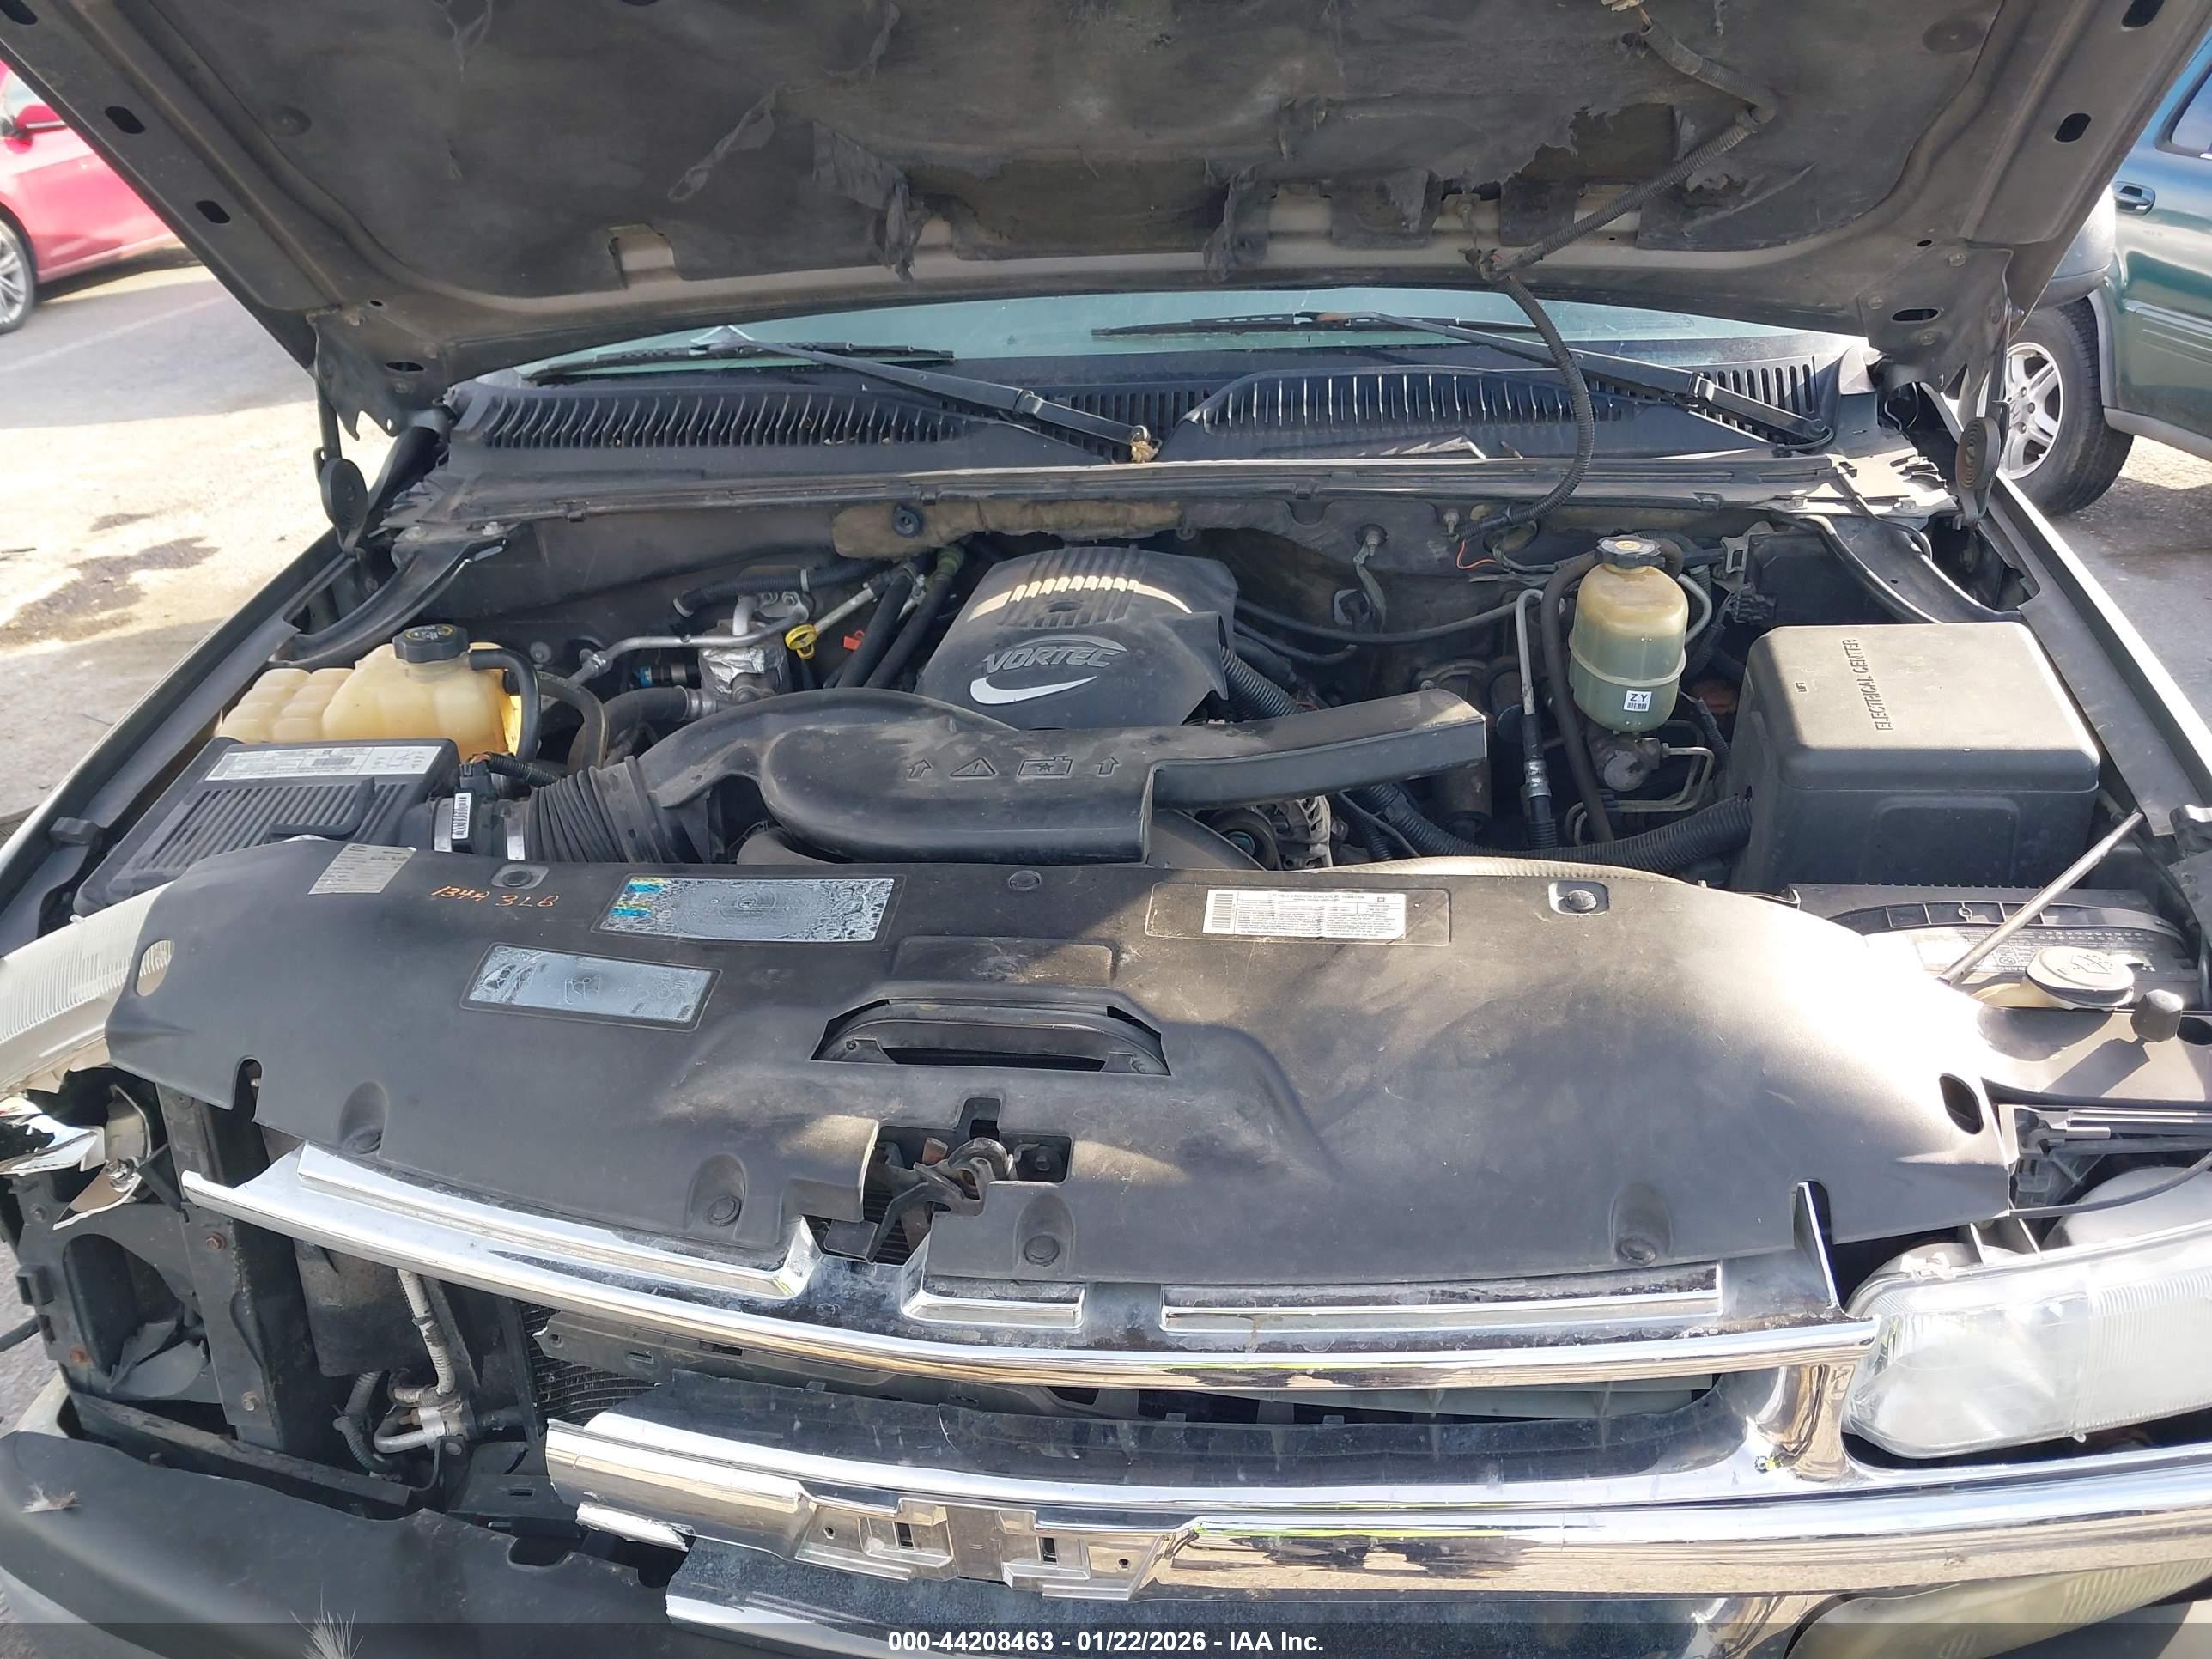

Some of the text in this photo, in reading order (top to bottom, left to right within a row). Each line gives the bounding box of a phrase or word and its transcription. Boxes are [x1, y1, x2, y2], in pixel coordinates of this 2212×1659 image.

[982, 646, 1121, 674] VORTEC
[1841, 639, 1893, 731] ELECTRICAL CENTER
